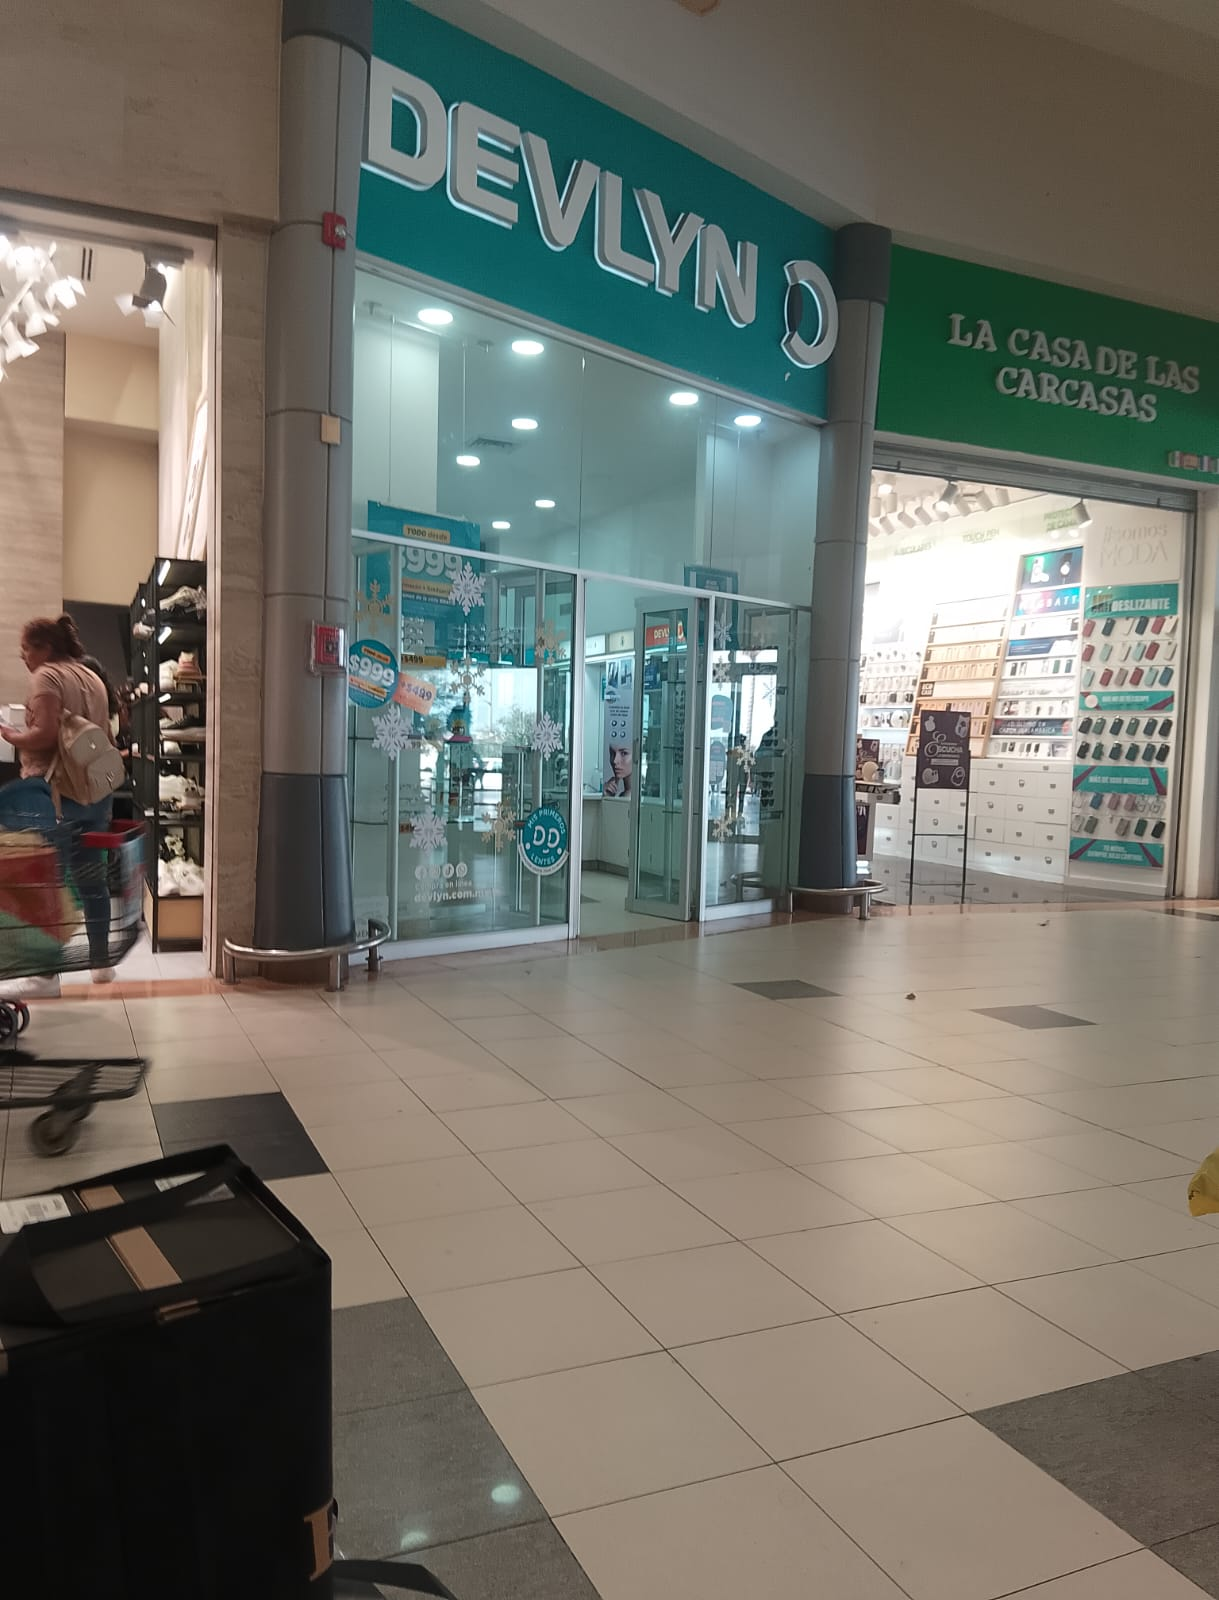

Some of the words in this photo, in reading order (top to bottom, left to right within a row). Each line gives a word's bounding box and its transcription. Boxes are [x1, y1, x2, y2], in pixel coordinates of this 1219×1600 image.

[360, 54, 758, 328] DEVLYN
[948, 313, 998, 352] LA
[1007, 328, 1091, 371] CASA
[1096, 346, 1138, 380] DE
[1145, 356, 1201, 394] LAS
[996, 366, 1158, 423] CARCASAS
[1100, 541, 1169, 567] MODA
[1111, 598, 1170, 612] DESLIZANTE
[349, 653, 395, 687] $999
[528, 815, 538, 828] MIS
[539, 808, 566, 834] PRIMEROS
[531, 853, 555, 866] LENTES
